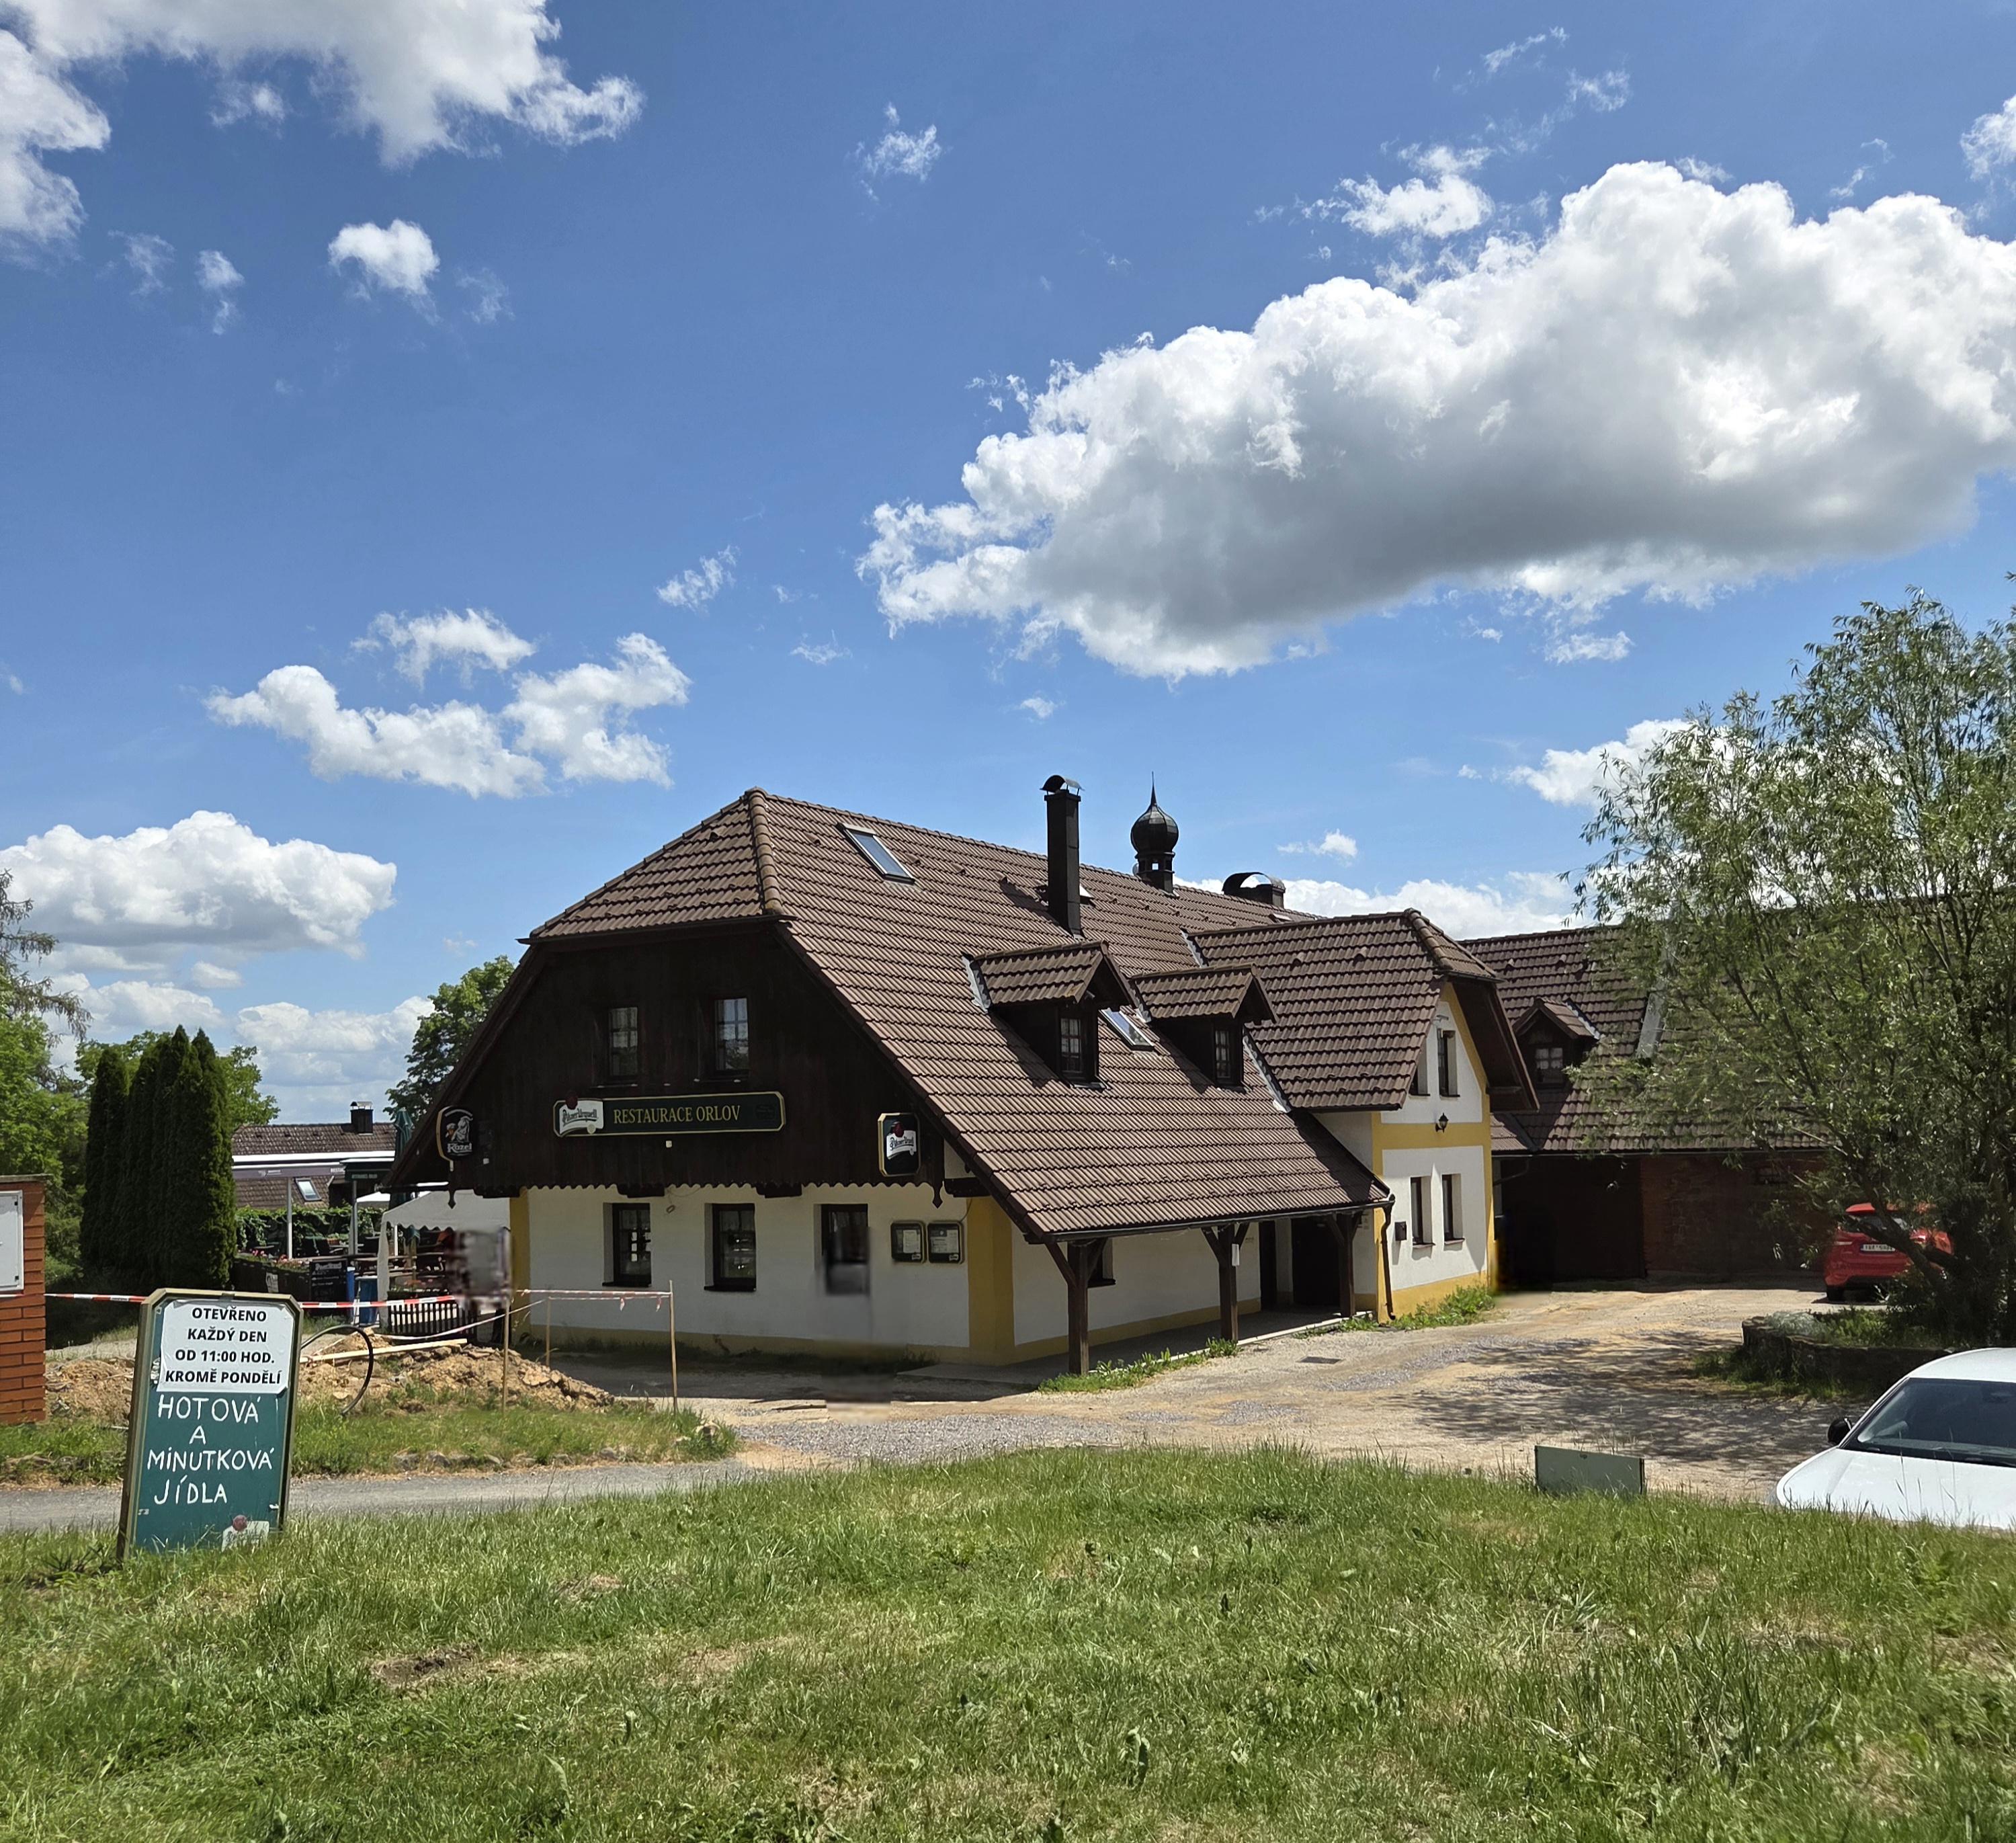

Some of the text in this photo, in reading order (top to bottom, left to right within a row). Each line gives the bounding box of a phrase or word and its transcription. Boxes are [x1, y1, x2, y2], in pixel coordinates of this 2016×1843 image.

[614, 1106, 694, 1124] RESTAURACE
[696, 1105, 741, 1121] ORLOV
[447, 1142, 472, 1153] Kozel
[192, 1306, 267, 1322] OTEVŘENO
[187, 1326, 267, 1342] KAŽDÝ DEN
[175, 1349, 275, 1364] OD 11:00 HOD.
[165, 1368, 282, 1385] KROMĚ PONDĚLÍ
[158, 1394, 261, 1424] HOTOVÁ
[189, 1425, 206, 1444] A
[154, 1474, 227, 1505] JÍDLA
